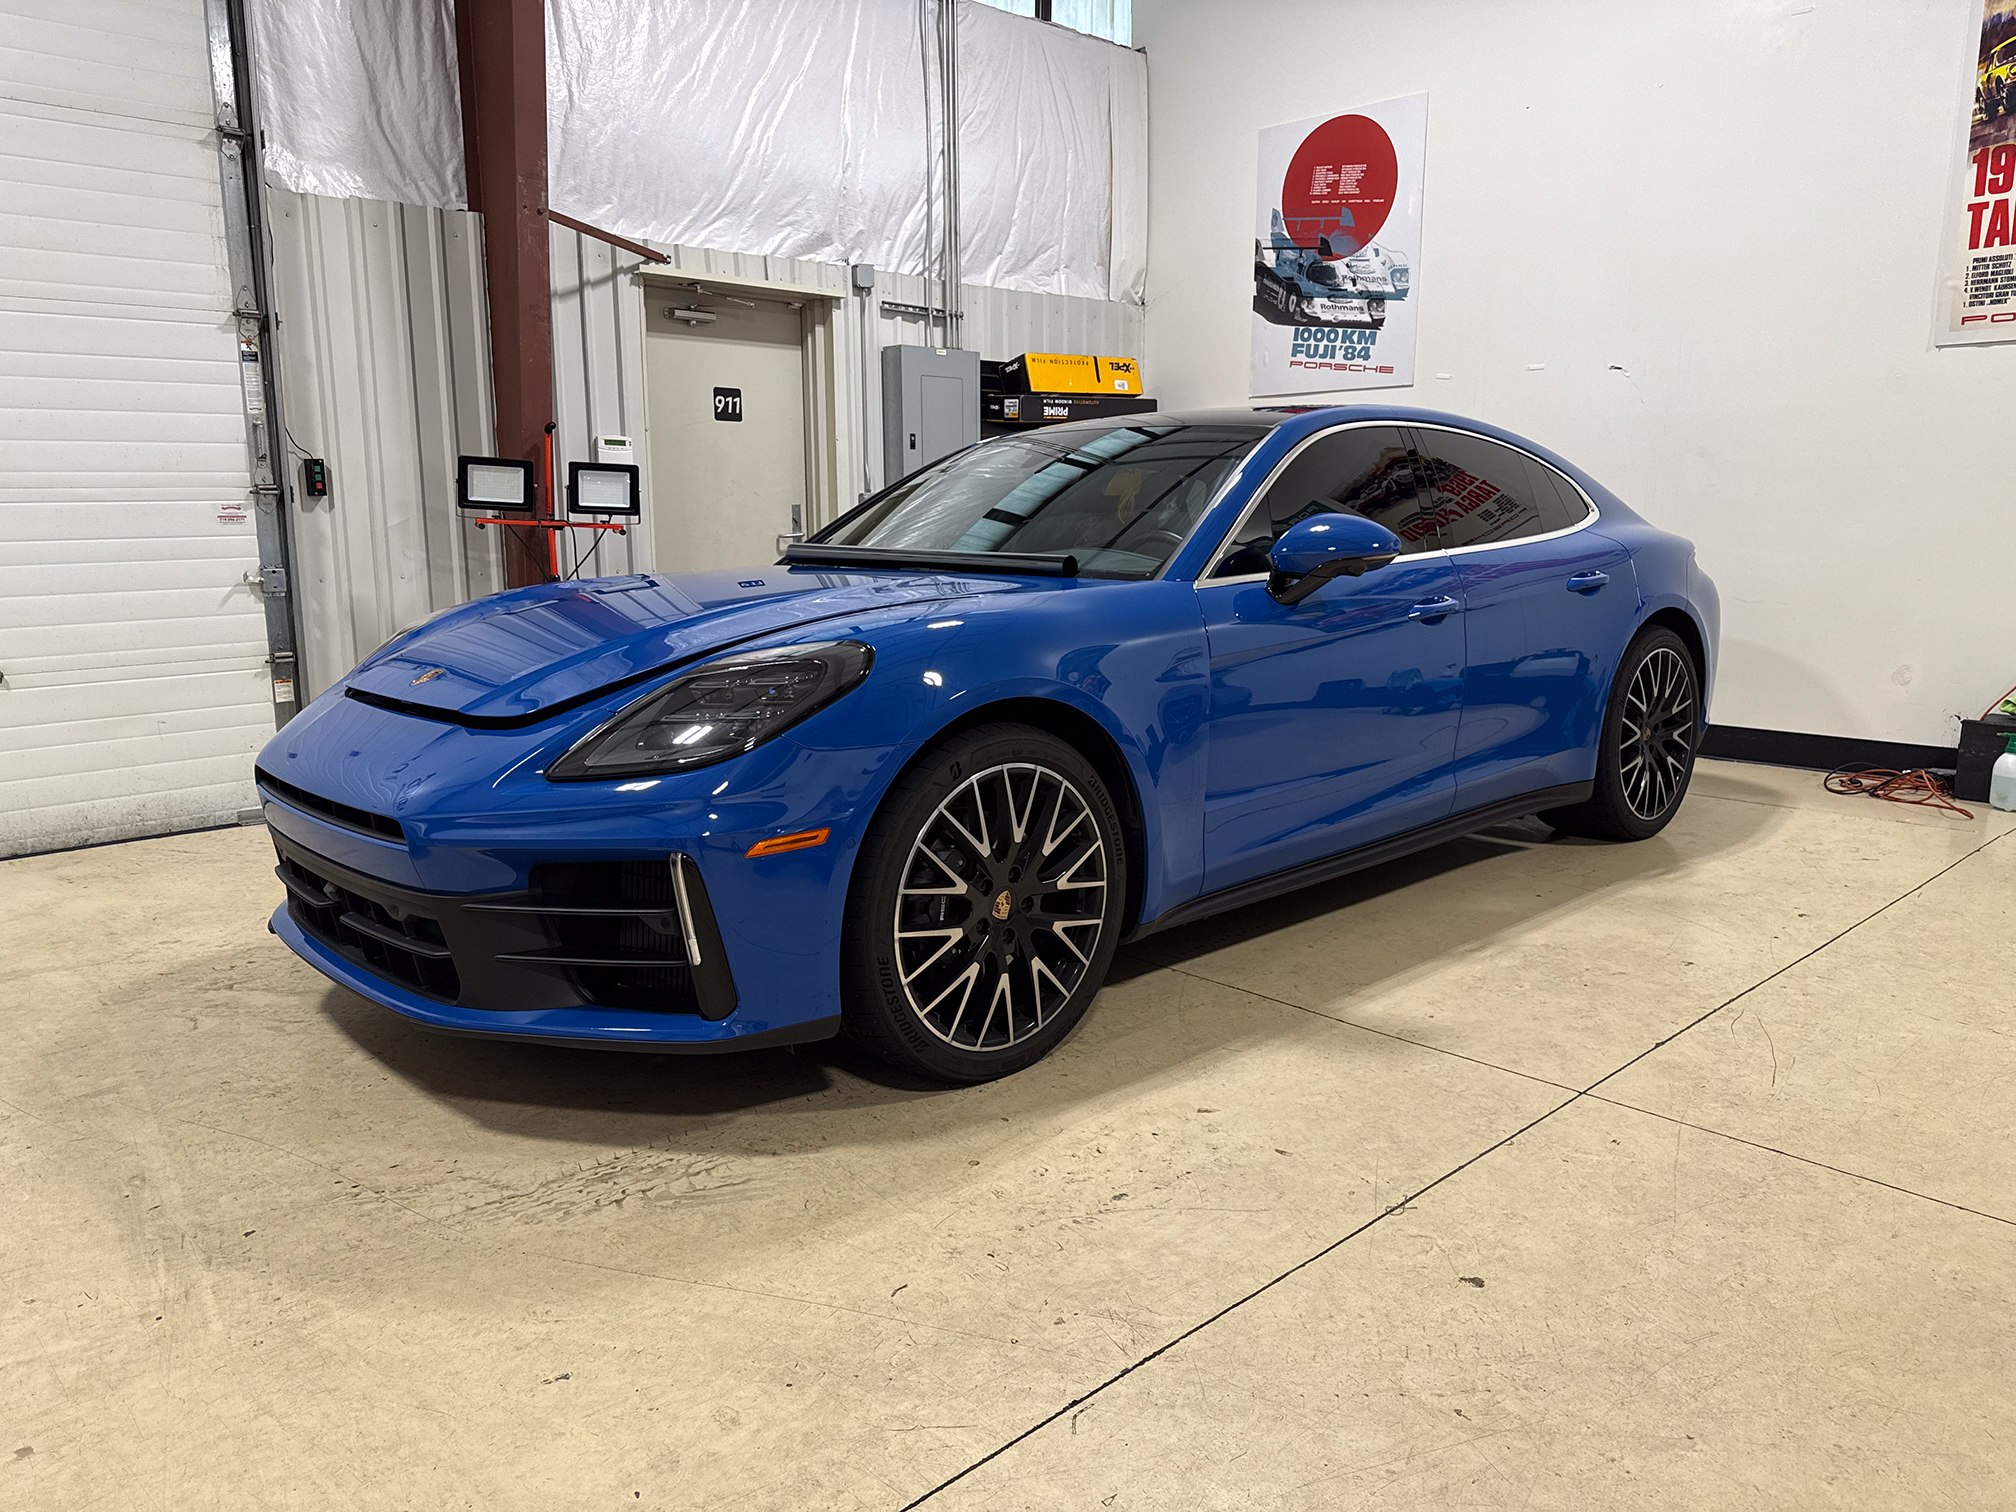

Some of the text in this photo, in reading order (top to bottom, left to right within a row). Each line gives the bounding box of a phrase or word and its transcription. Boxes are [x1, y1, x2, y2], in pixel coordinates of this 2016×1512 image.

[1972, 263, 1990, 271] MITTER
[1970, 277, 1999, 286] HERRMANN
[1320, 303, 1365, 312] Rothmans
[1293, 327, 1377, 345] 1000 KM
[1108, 362, 1133, 373] XPEL
[1289, 361, 1394, 374] PORSCHE
[715, 395, 740, 414] 911
[1043, 406, 1069, 416] PRIME
[877, 956, 930, 1053] BRIDGESTONE
